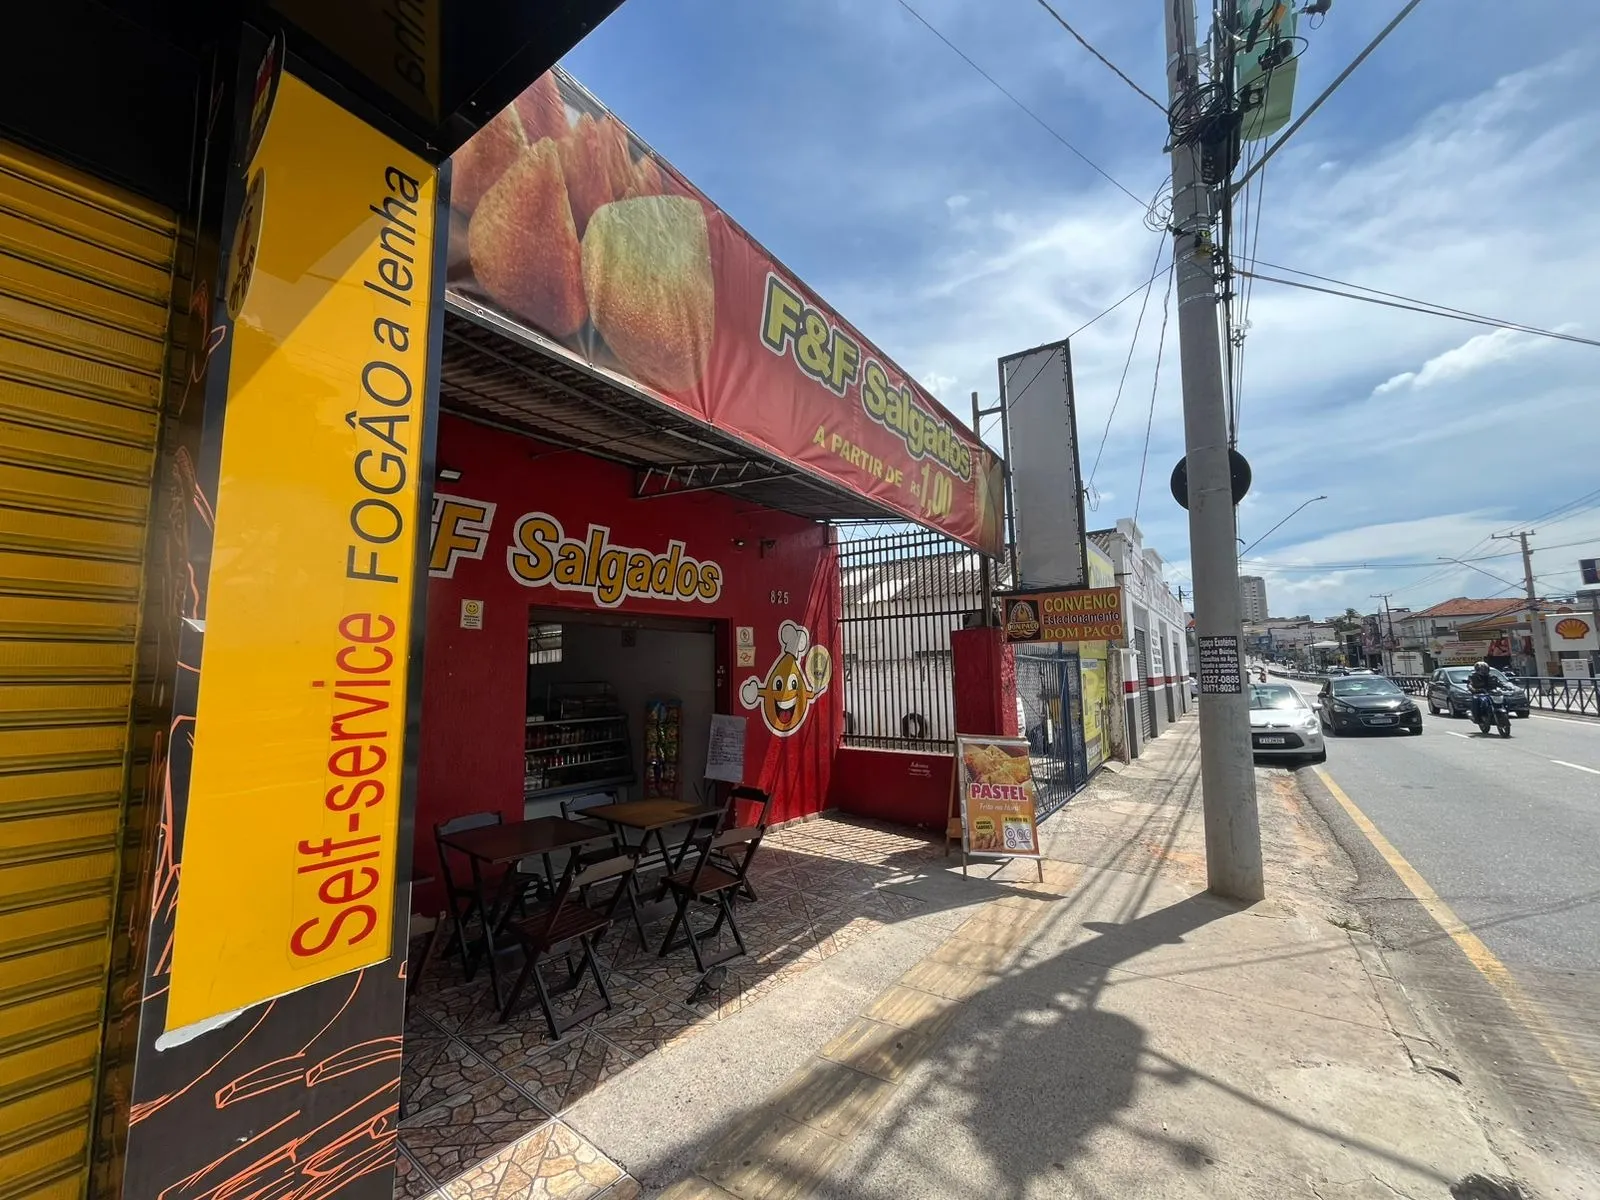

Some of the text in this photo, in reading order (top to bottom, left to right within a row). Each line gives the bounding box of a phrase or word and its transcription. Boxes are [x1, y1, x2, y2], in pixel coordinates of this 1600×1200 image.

[363, 165, 419, 306] lenha
[373, 317, 409, 352] a
[760, 272, 972, 482] F&F Salgados
[813, 425, 826, 448] A
[831, 433, 883, 478] PARTIR
[884, 465, 904, 488] DE
[920, 463, 953, 518] 1,00
[507, 512, 723, 608] Salgados
[770, 590, 789, 604] 825
[1043, 593, 1118, 613] CONVENIO
[1042, 611, 1119, 625] Estacionamento
[1044, 624, 1122, 640] DOM PACO
[290, 612, 395, 957] Self-service
[970, 783, 1028, 801] PASTEL
